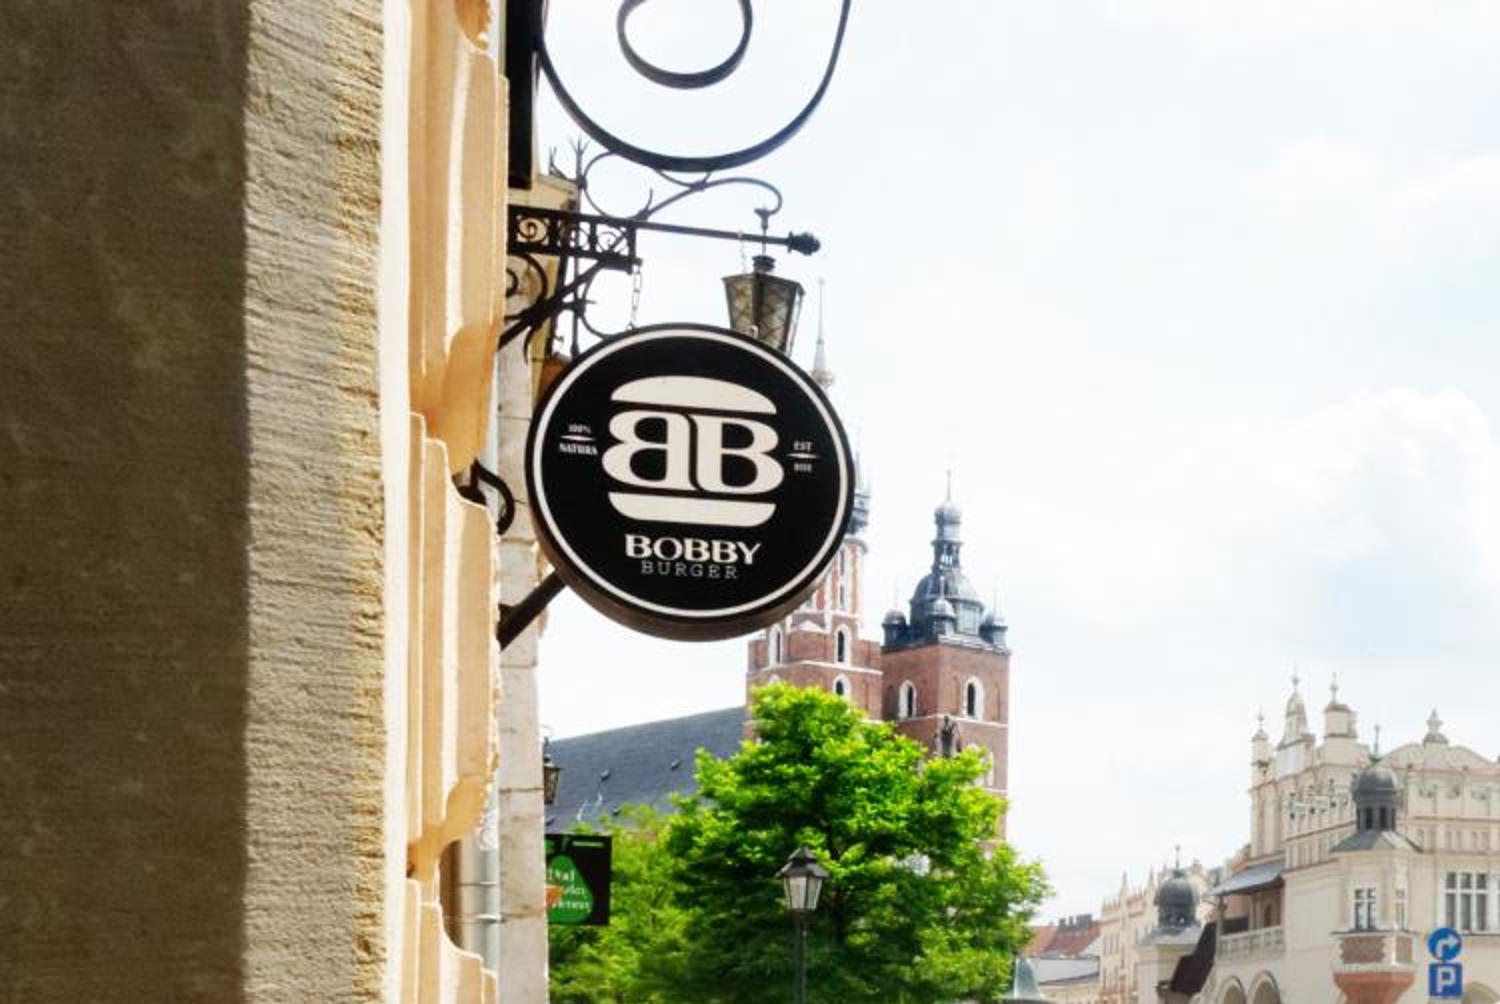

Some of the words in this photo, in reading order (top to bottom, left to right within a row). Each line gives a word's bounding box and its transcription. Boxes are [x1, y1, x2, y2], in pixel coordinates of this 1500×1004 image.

[794, 441, 812, 451] EST
[625, 534, 761, 564] BOBBY
[641, 560, 737, 579] BURGER
[1437, 966, 1456, 992] P
